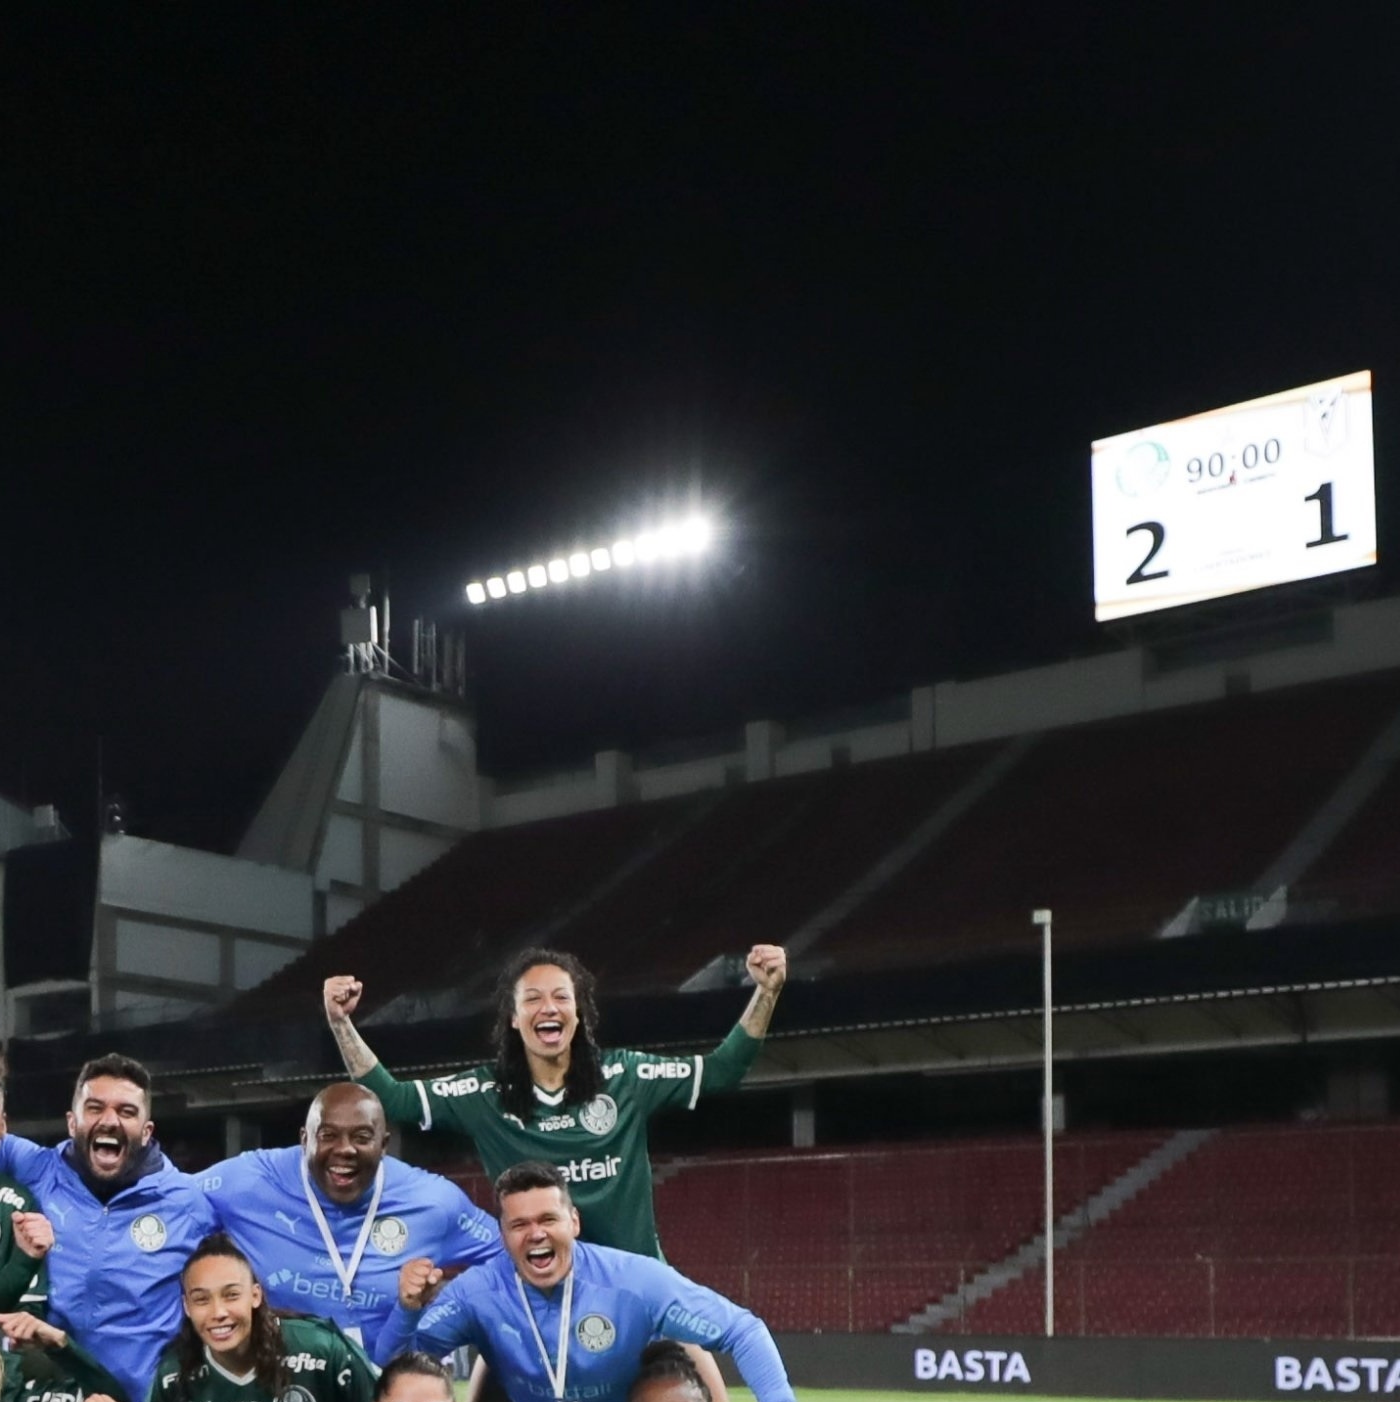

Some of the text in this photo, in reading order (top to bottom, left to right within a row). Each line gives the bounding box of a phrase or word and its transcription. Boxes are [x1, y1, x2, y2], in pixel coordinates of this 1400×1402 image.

[1185, 437, 1282, 483] 90:00
[1304, 482, 1349, 549] 1
[1126, 521, 1169, 585] 2
[637, 1062, 692, 1080] CIMED
[556, 1154, 622, 1183] etfair
[665, 1303, 723, 1341] CIMED
[281, 1352, 327, 1373] refisa
[914, 1349, 1031, 1383] BASTA
